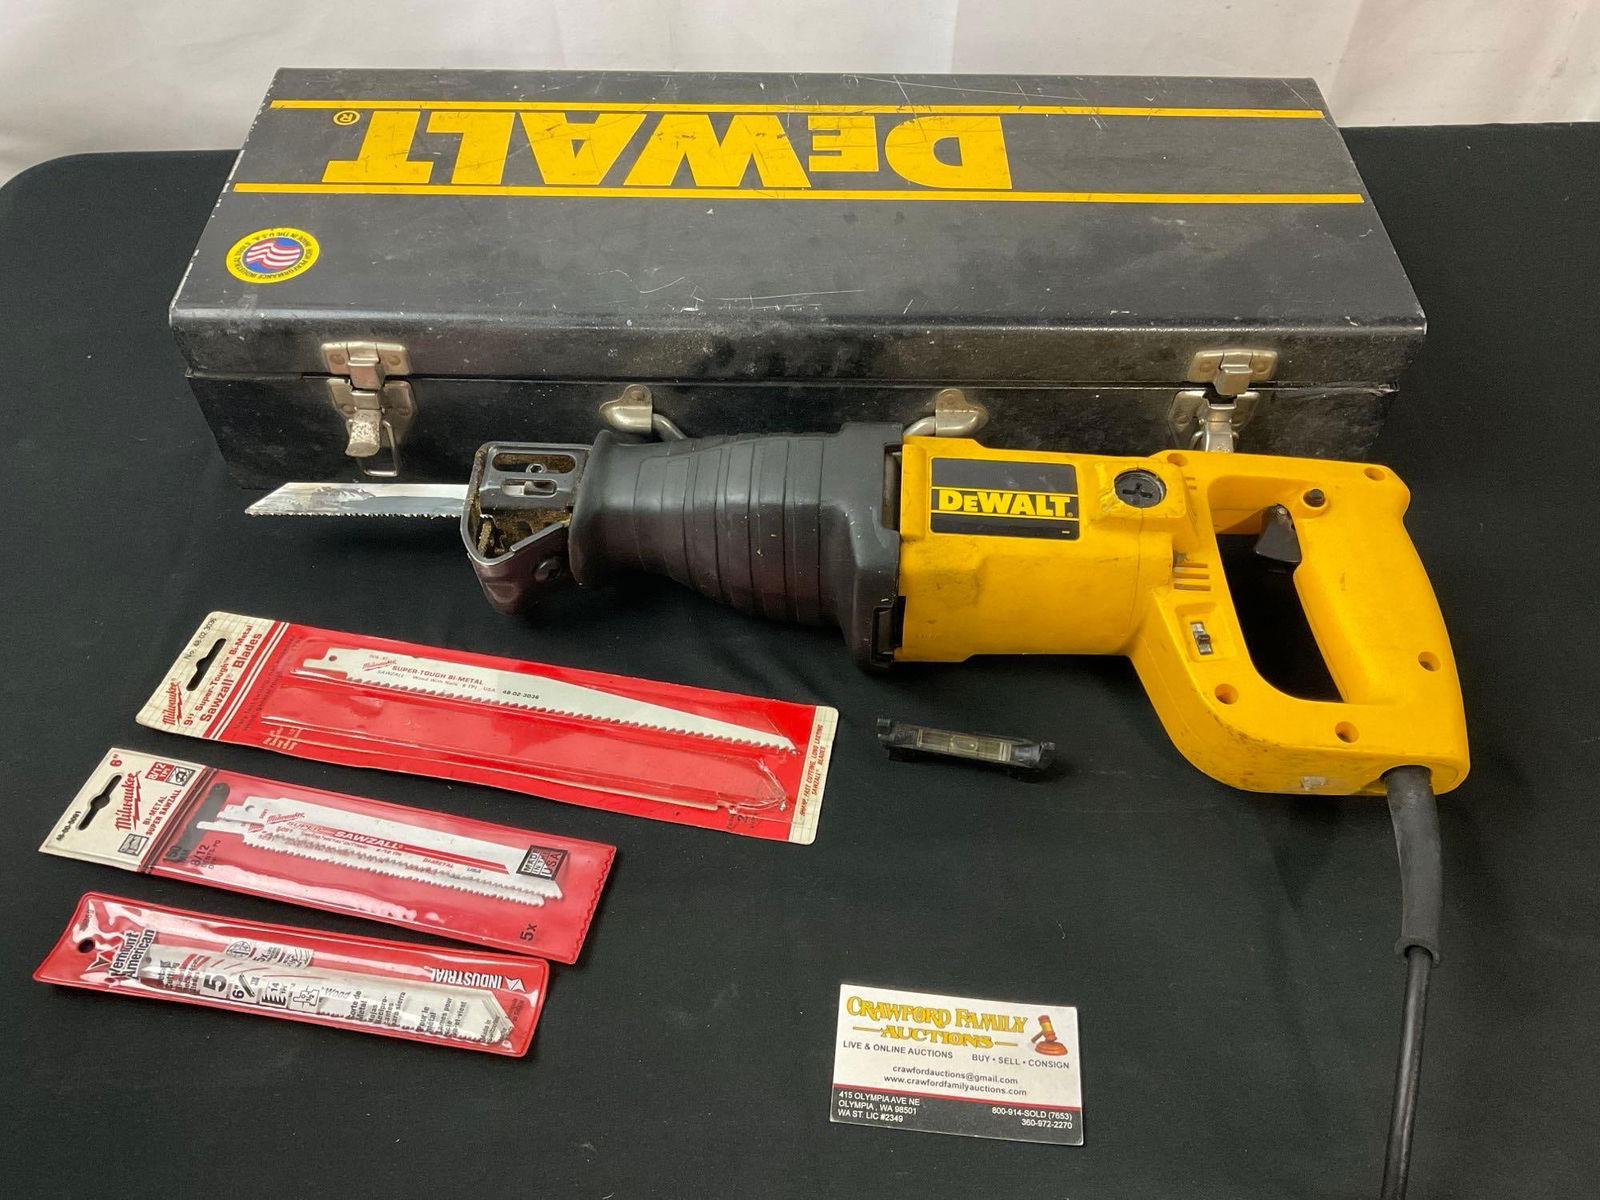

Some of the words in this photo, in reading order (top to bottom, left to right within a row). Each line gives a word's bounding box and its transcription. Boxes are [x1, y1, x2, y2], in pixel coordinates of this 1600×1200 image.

[232, 632, 263, 669] Blades
[162, 679, 180, 726] Milwaukee
[148, 761, 166, 781] 8/12
[115, 772, 139, 832] Milwaukee
[143, 796, 167, 825] BI-METAL
[145, 812, 162, 836] SUPER
[160, 789, 182, 815] SAWZALL
[334, 831, 401, 850] SAWZALL
[541, 853, 561, 876] USA
[122, 929, 155, 980] American
[203, 973, 228, 993] 5
[430, 967, 504, 990] INDUSTRIAL
[846, 996, 951, 1028] CRAWFORD
[955, 1008, 1028, 1034] FAMILY
[880, 1025, 995, 1049] AUCTIONS
[843, 1040, 862, 1050] LIVE
[864, 1042, 871, 1051] &
[873, 1043, 906, 1055] ONLINE
[908, 1047, 954, 1059] AUCTIONS
[972, 1053, 991, 1063] BUY
[998, 1056, 1021, 1066] SELL
[1028, 1059, 1070, 1070] CONSIGN
[892, 1064, 1019, 1085] crawfordauctions@gmail.com
[884, 1075, 1027, 1096] www.crawfordfamilyauctions.com
[839, 1091, 853, 1099] 415
[854, 1092, 890, 1102] OLYMPIA
[889, 1096, 907, 1105] AVE
[908, 1098, 920, 1106] NE
[838, 1109, 851, 1117] WA
[852, 1110, 864, 1119] ST.
[866, 1112, 879, 1120] LIC
[880, 1113, 904, 1123] #2349
[880, 1104, 893, 1112] WA
[894, 1106, 917, 1115] 98501
[992, 1107, 1047, 1119] 800-914-SOLD
[1048, 1111, 1073, 1121] (7653)
[1021, 1119, 1073, 1130] 360-972-2270
